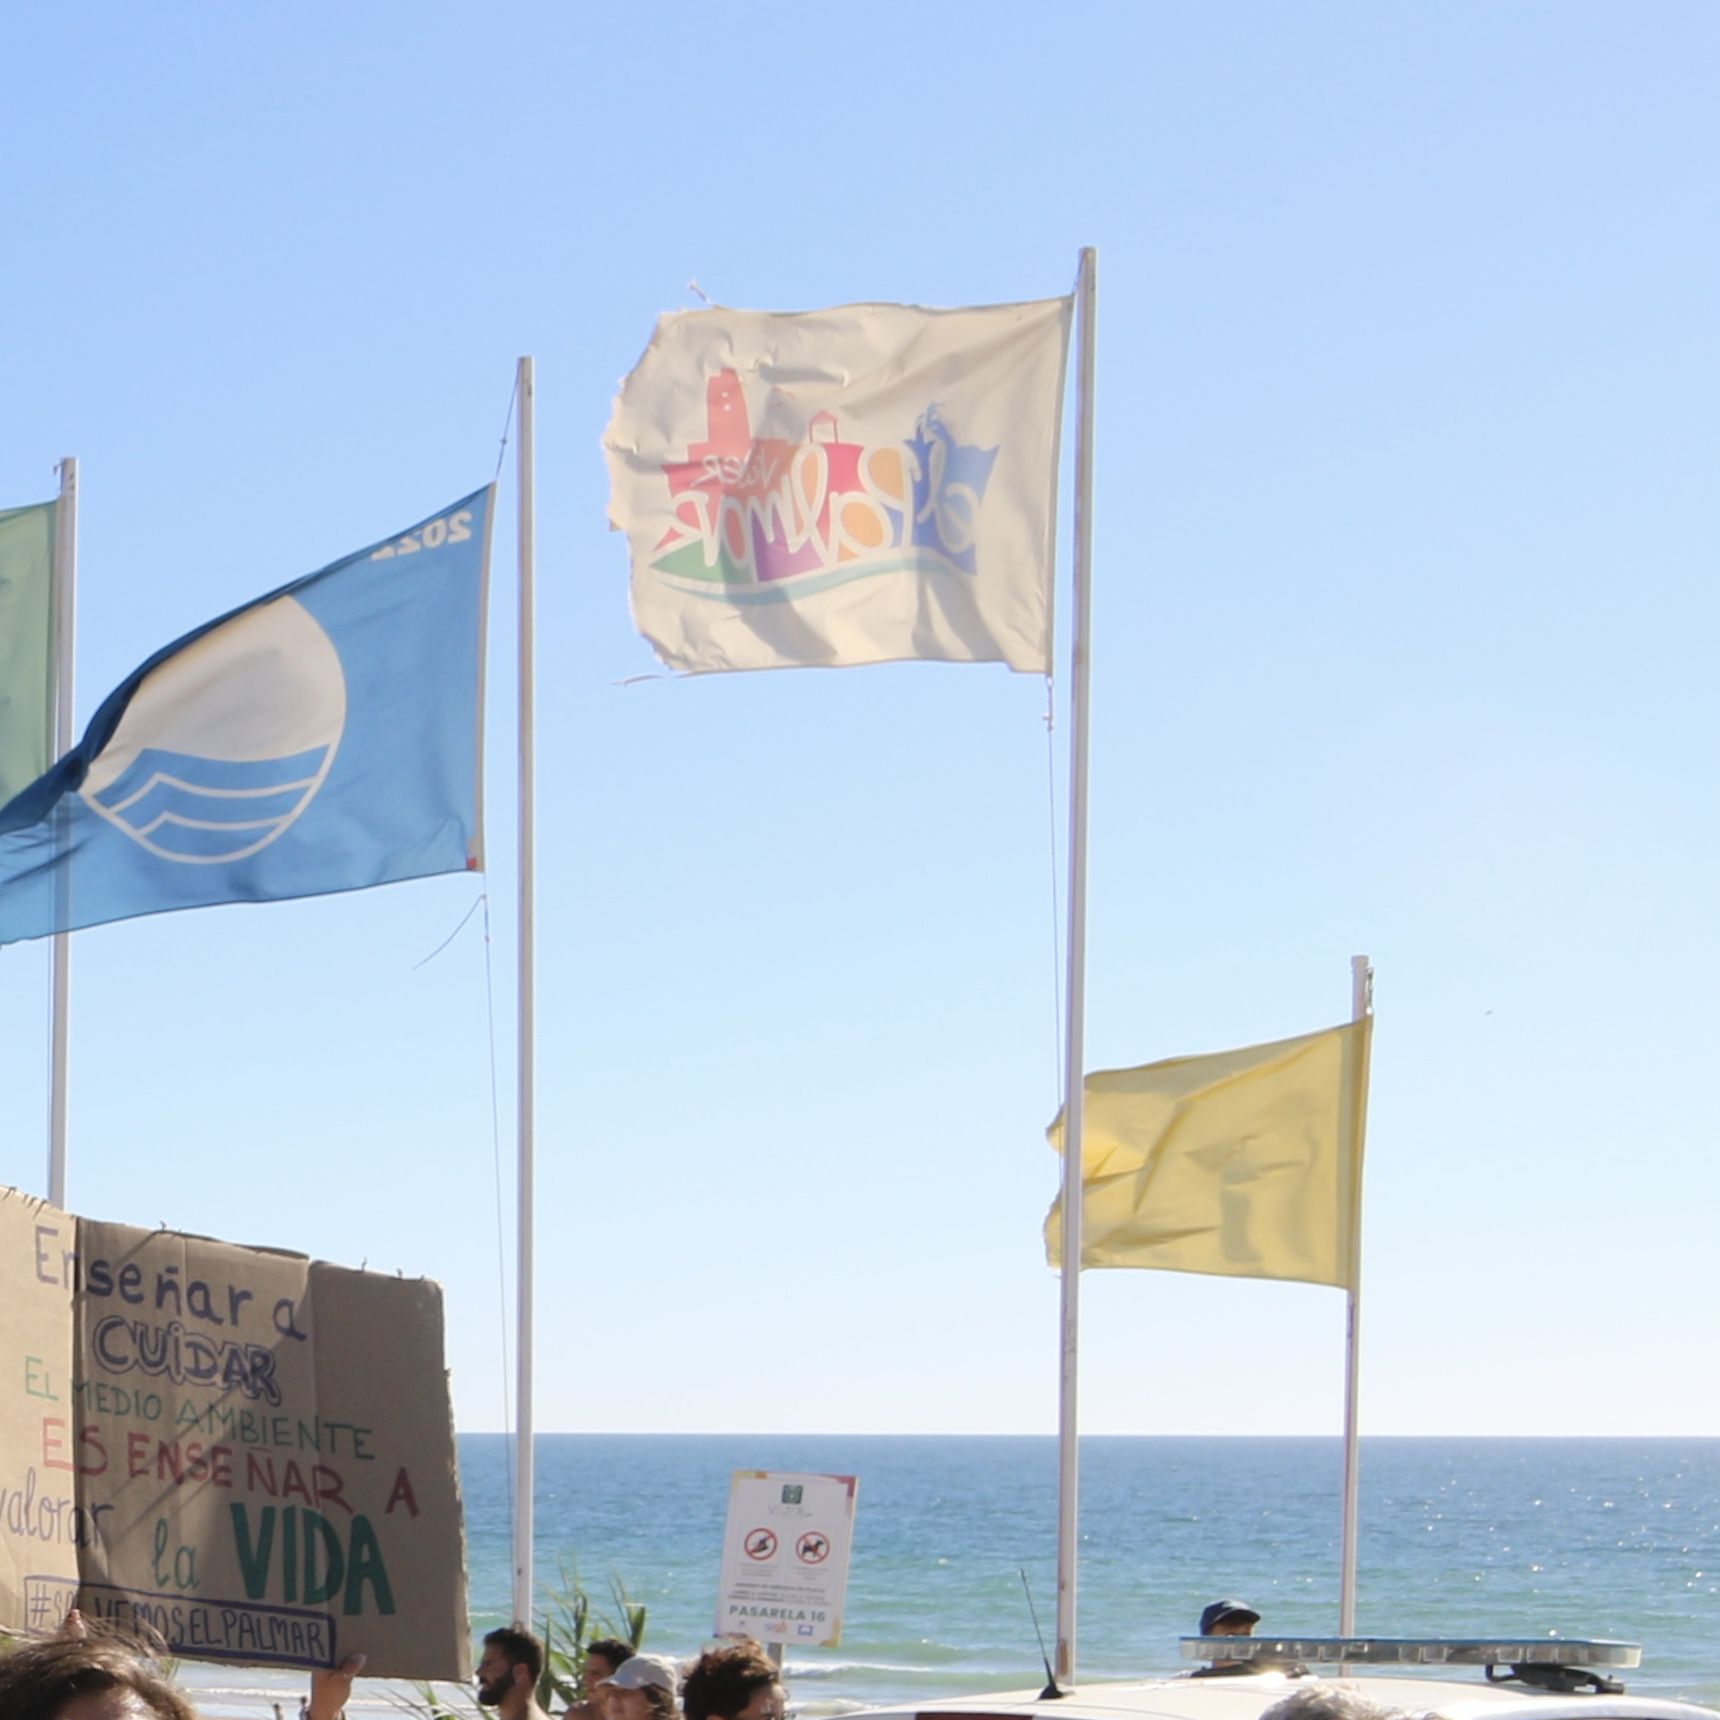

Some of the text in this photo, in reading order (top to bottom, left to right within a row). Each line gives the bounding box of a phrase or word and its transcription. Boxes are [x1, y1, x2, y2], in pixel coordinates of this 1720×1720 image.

[34, 1224, 254, 1329] Enseñar
[25, 1356, 375, 1461] EL MEDIO AMBIENTE
[42, 1417, 419, 1517] ES ENSEÑAR A
[152, 1516, 200, 1591] la
[231, 1502, 396, 1616] VIDA
[729, 1604, 826, 1623] PASARELA 16
